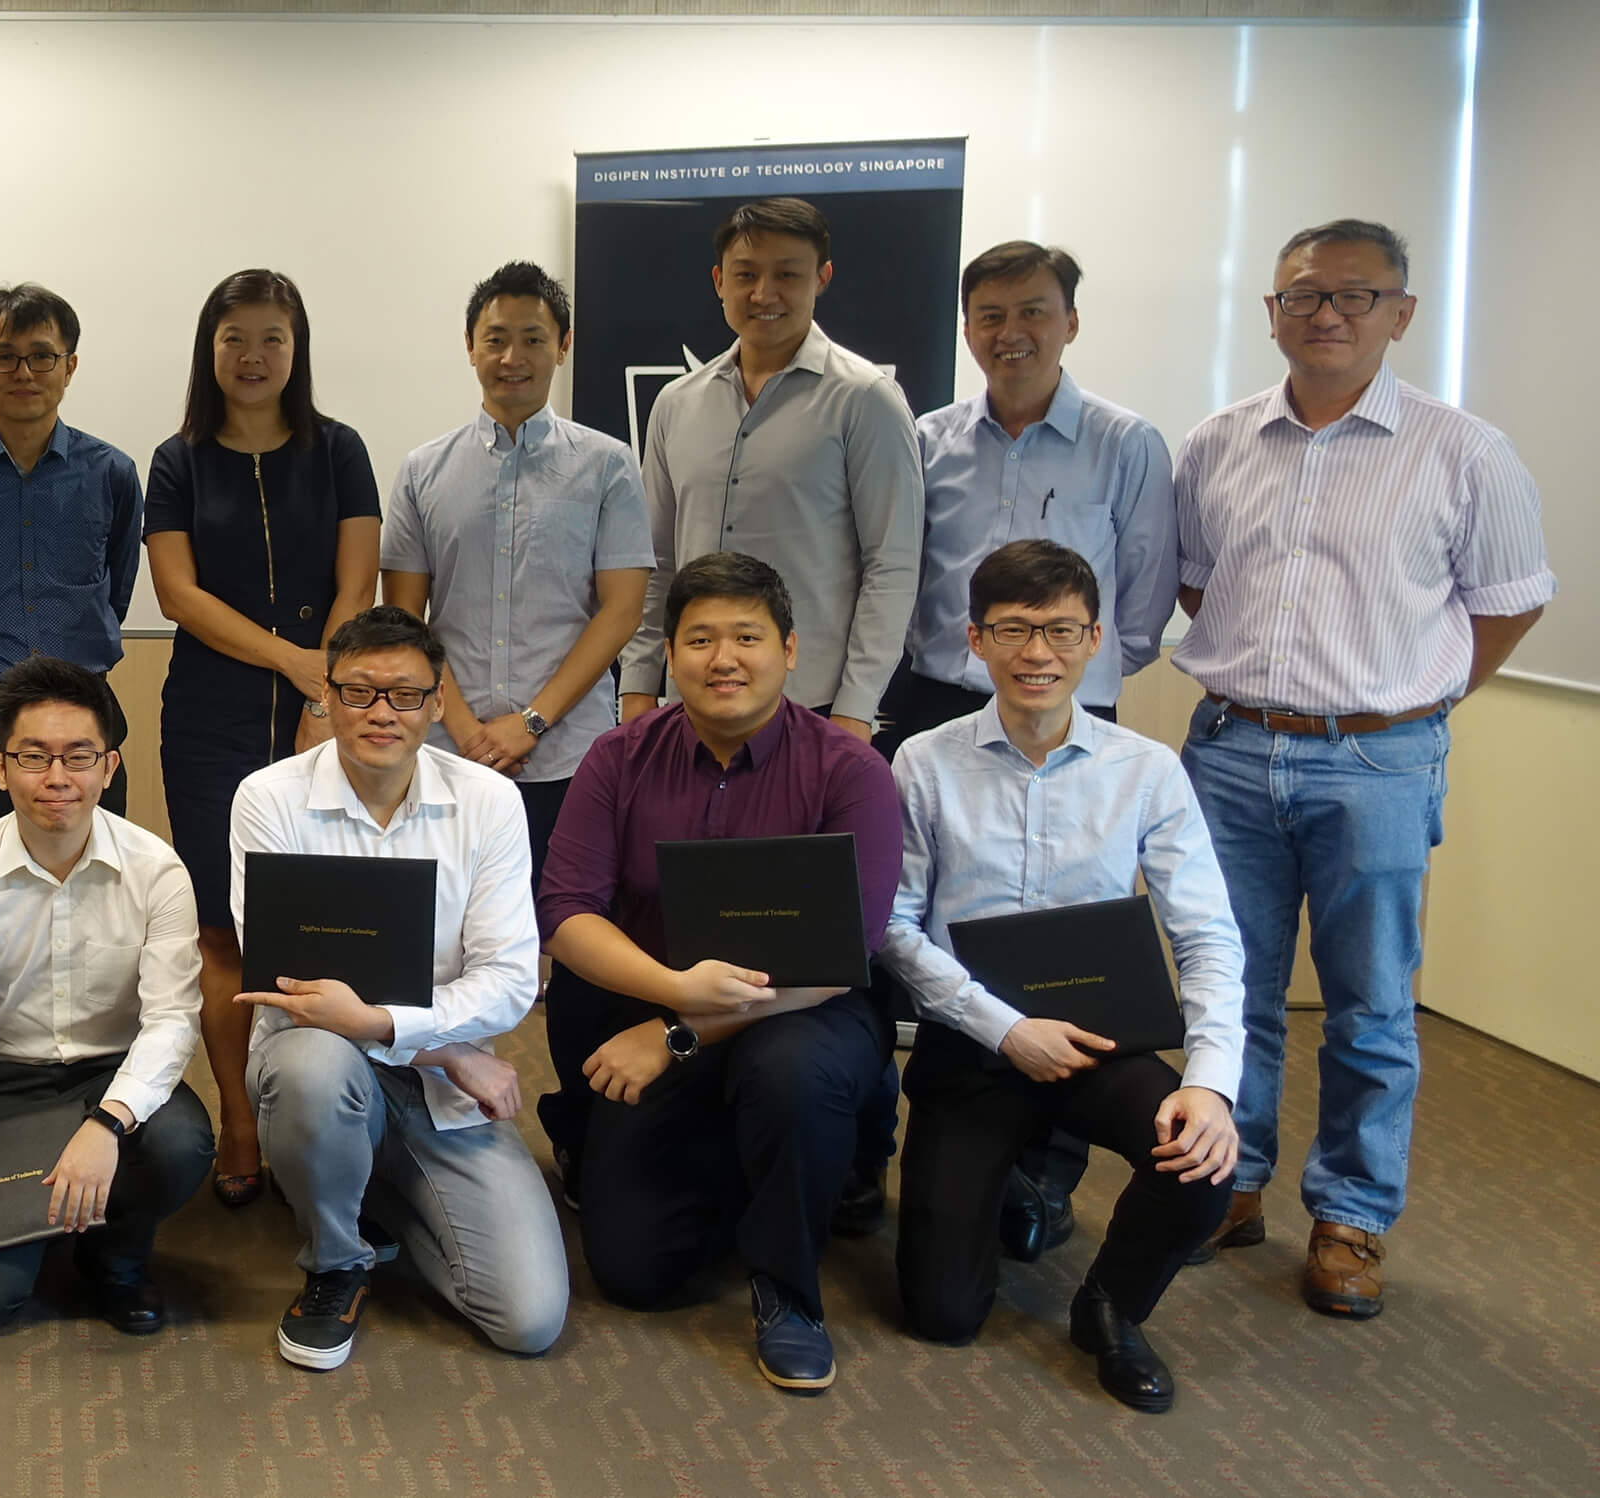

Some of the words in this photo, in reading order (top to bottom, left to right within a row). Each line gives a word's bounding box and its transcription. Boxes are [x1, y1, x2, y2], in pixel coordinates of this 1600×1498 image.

[594, 170, 649, 182] DIGIPEN
[655, 167, 726, 180] INSTITUTE
[731, 165, 751, 177] OF
[756, 161, 853, 176] TECHNOLOGY
[859, 158, 945, 173] SINGAPORE
